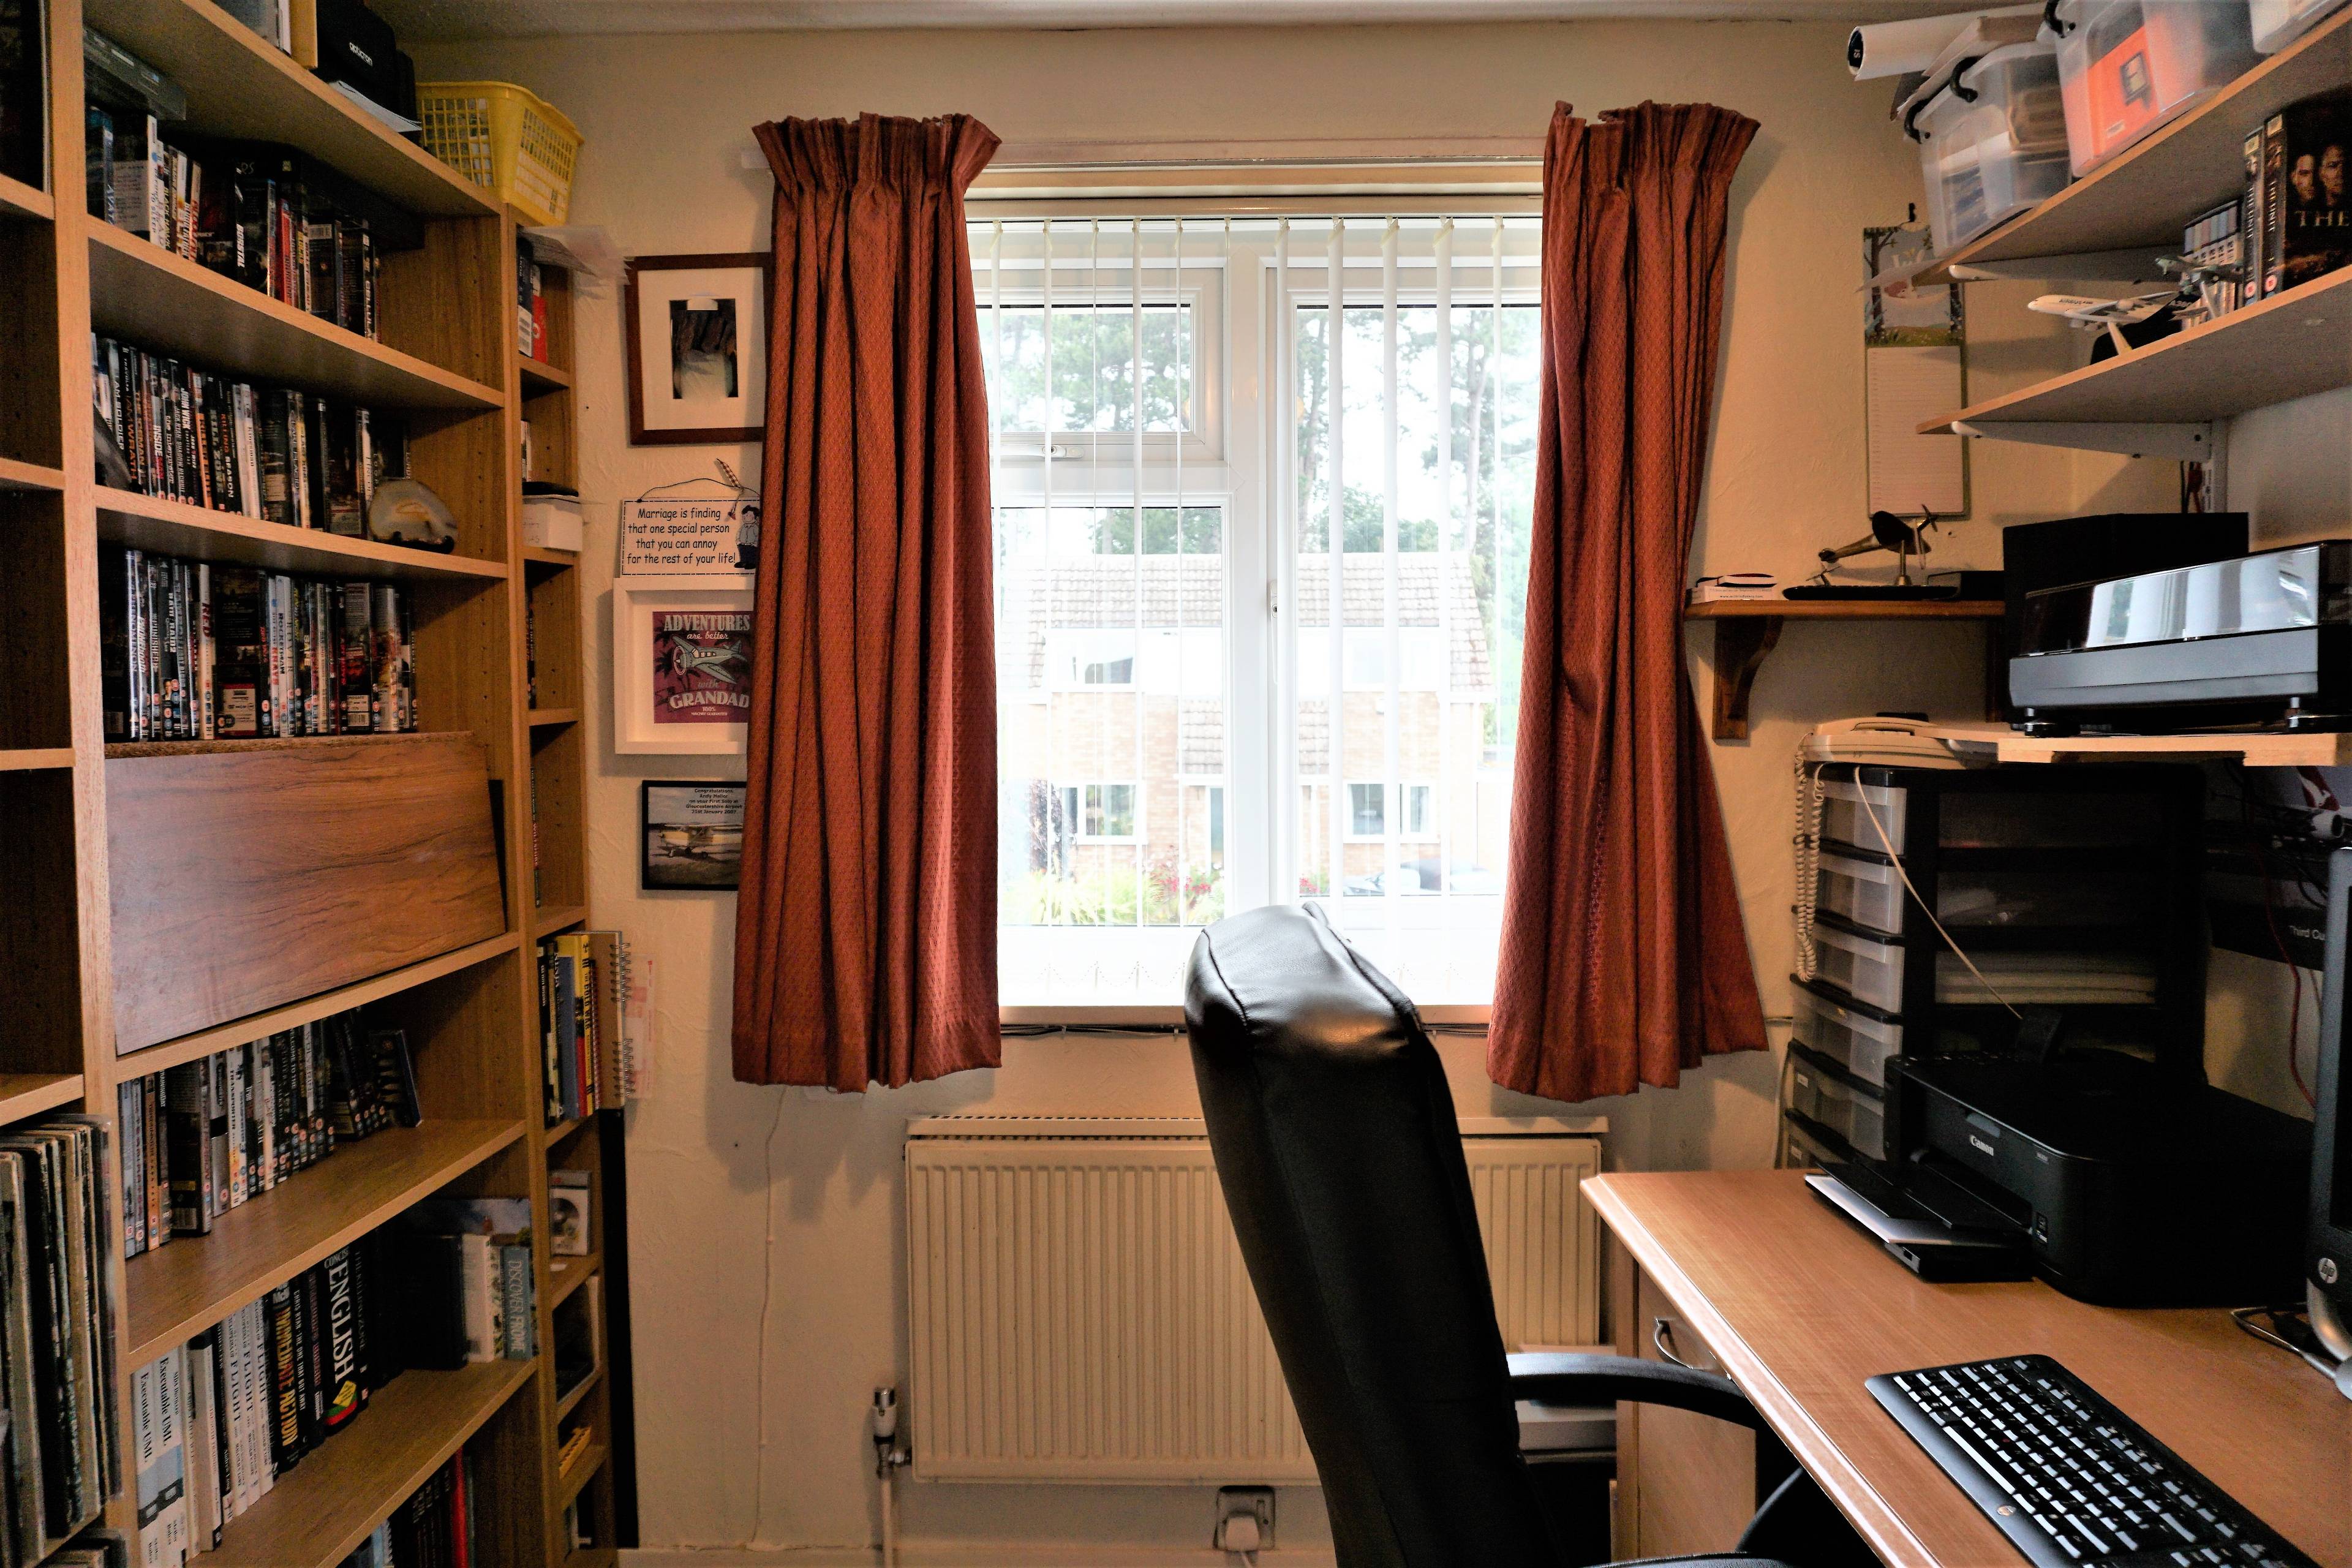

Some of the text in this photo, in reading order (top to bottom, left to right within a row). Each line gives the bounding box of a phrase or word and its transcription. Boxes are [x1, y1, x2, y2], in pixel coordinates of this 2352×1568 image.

[349, 42, 372, 66] opticron
[2295, 209, 2350, 227] THE
[236, 223, 245, 268] BORSTAL
[115, 401, 124, 450] SOLDIER
[180, 388, 190, 429] JOHN WICK
[127, 424, 138, 480] WRATH
[153, 425, 163, 456] INSIDE
[628, 523, 647, 533] that
[667, 523, 697, 536] special
[700, 525, 729, 536] person
[638, 508, 721, 521] Marriage is finding
[627, 552, 736, 566] for the rest of your life!
[636, 538, 717, 551] that you can annoy
[201, 602, 211, 638] RED
[663, 614, 750, 631] ADVENTURES
[669, 690, 750, 709] GRANDAD
[698, 679, 720, 689] with
[1969, 1134, 1994, 1157] Canon
[329, 1259, 353, 1384] ENGLISH
[508, 1259, 526, 1352] DISCOVER FROME
[230, 1360, 241, 1422] FLIGHT
[243, 1351, 253, 1412] FLIGHT
[257, 1344, 266, 1403] FLIGHT
[275, 1306, 298, 1446] IMMEDIATE ACTION
[140, 1372, 153, 1463] Executable UML
[160, 1357, 172, 1447] Executable UML
